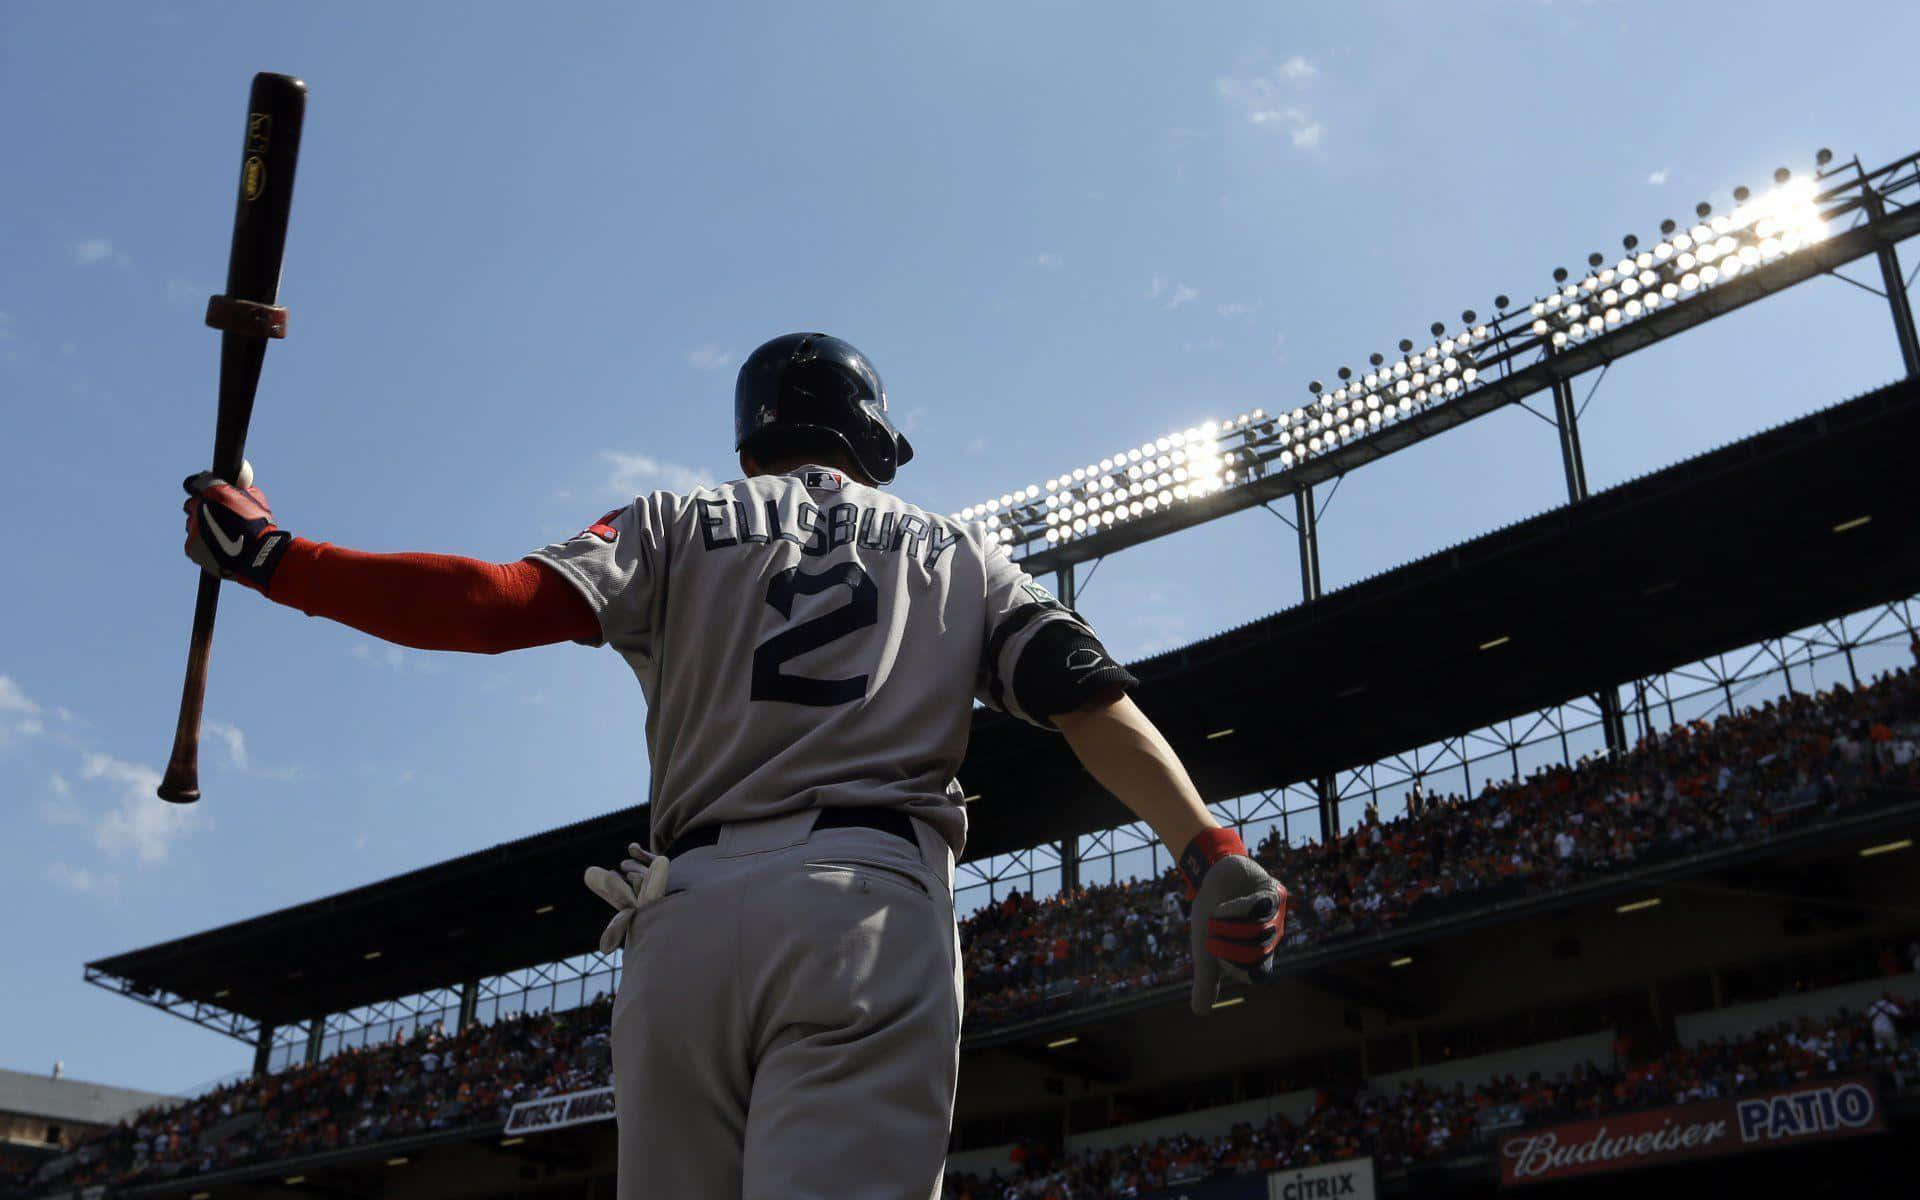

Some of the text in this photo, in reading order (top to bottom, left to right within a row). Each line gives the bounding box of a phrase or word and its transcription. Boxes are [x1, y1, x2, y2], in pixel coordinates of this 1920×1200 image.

[697, 499, 962, 569] ELLSBURY
[750, 561, 878, 706] 2
[1503, 1083, 1875, 1178] Budweiser PATIO
